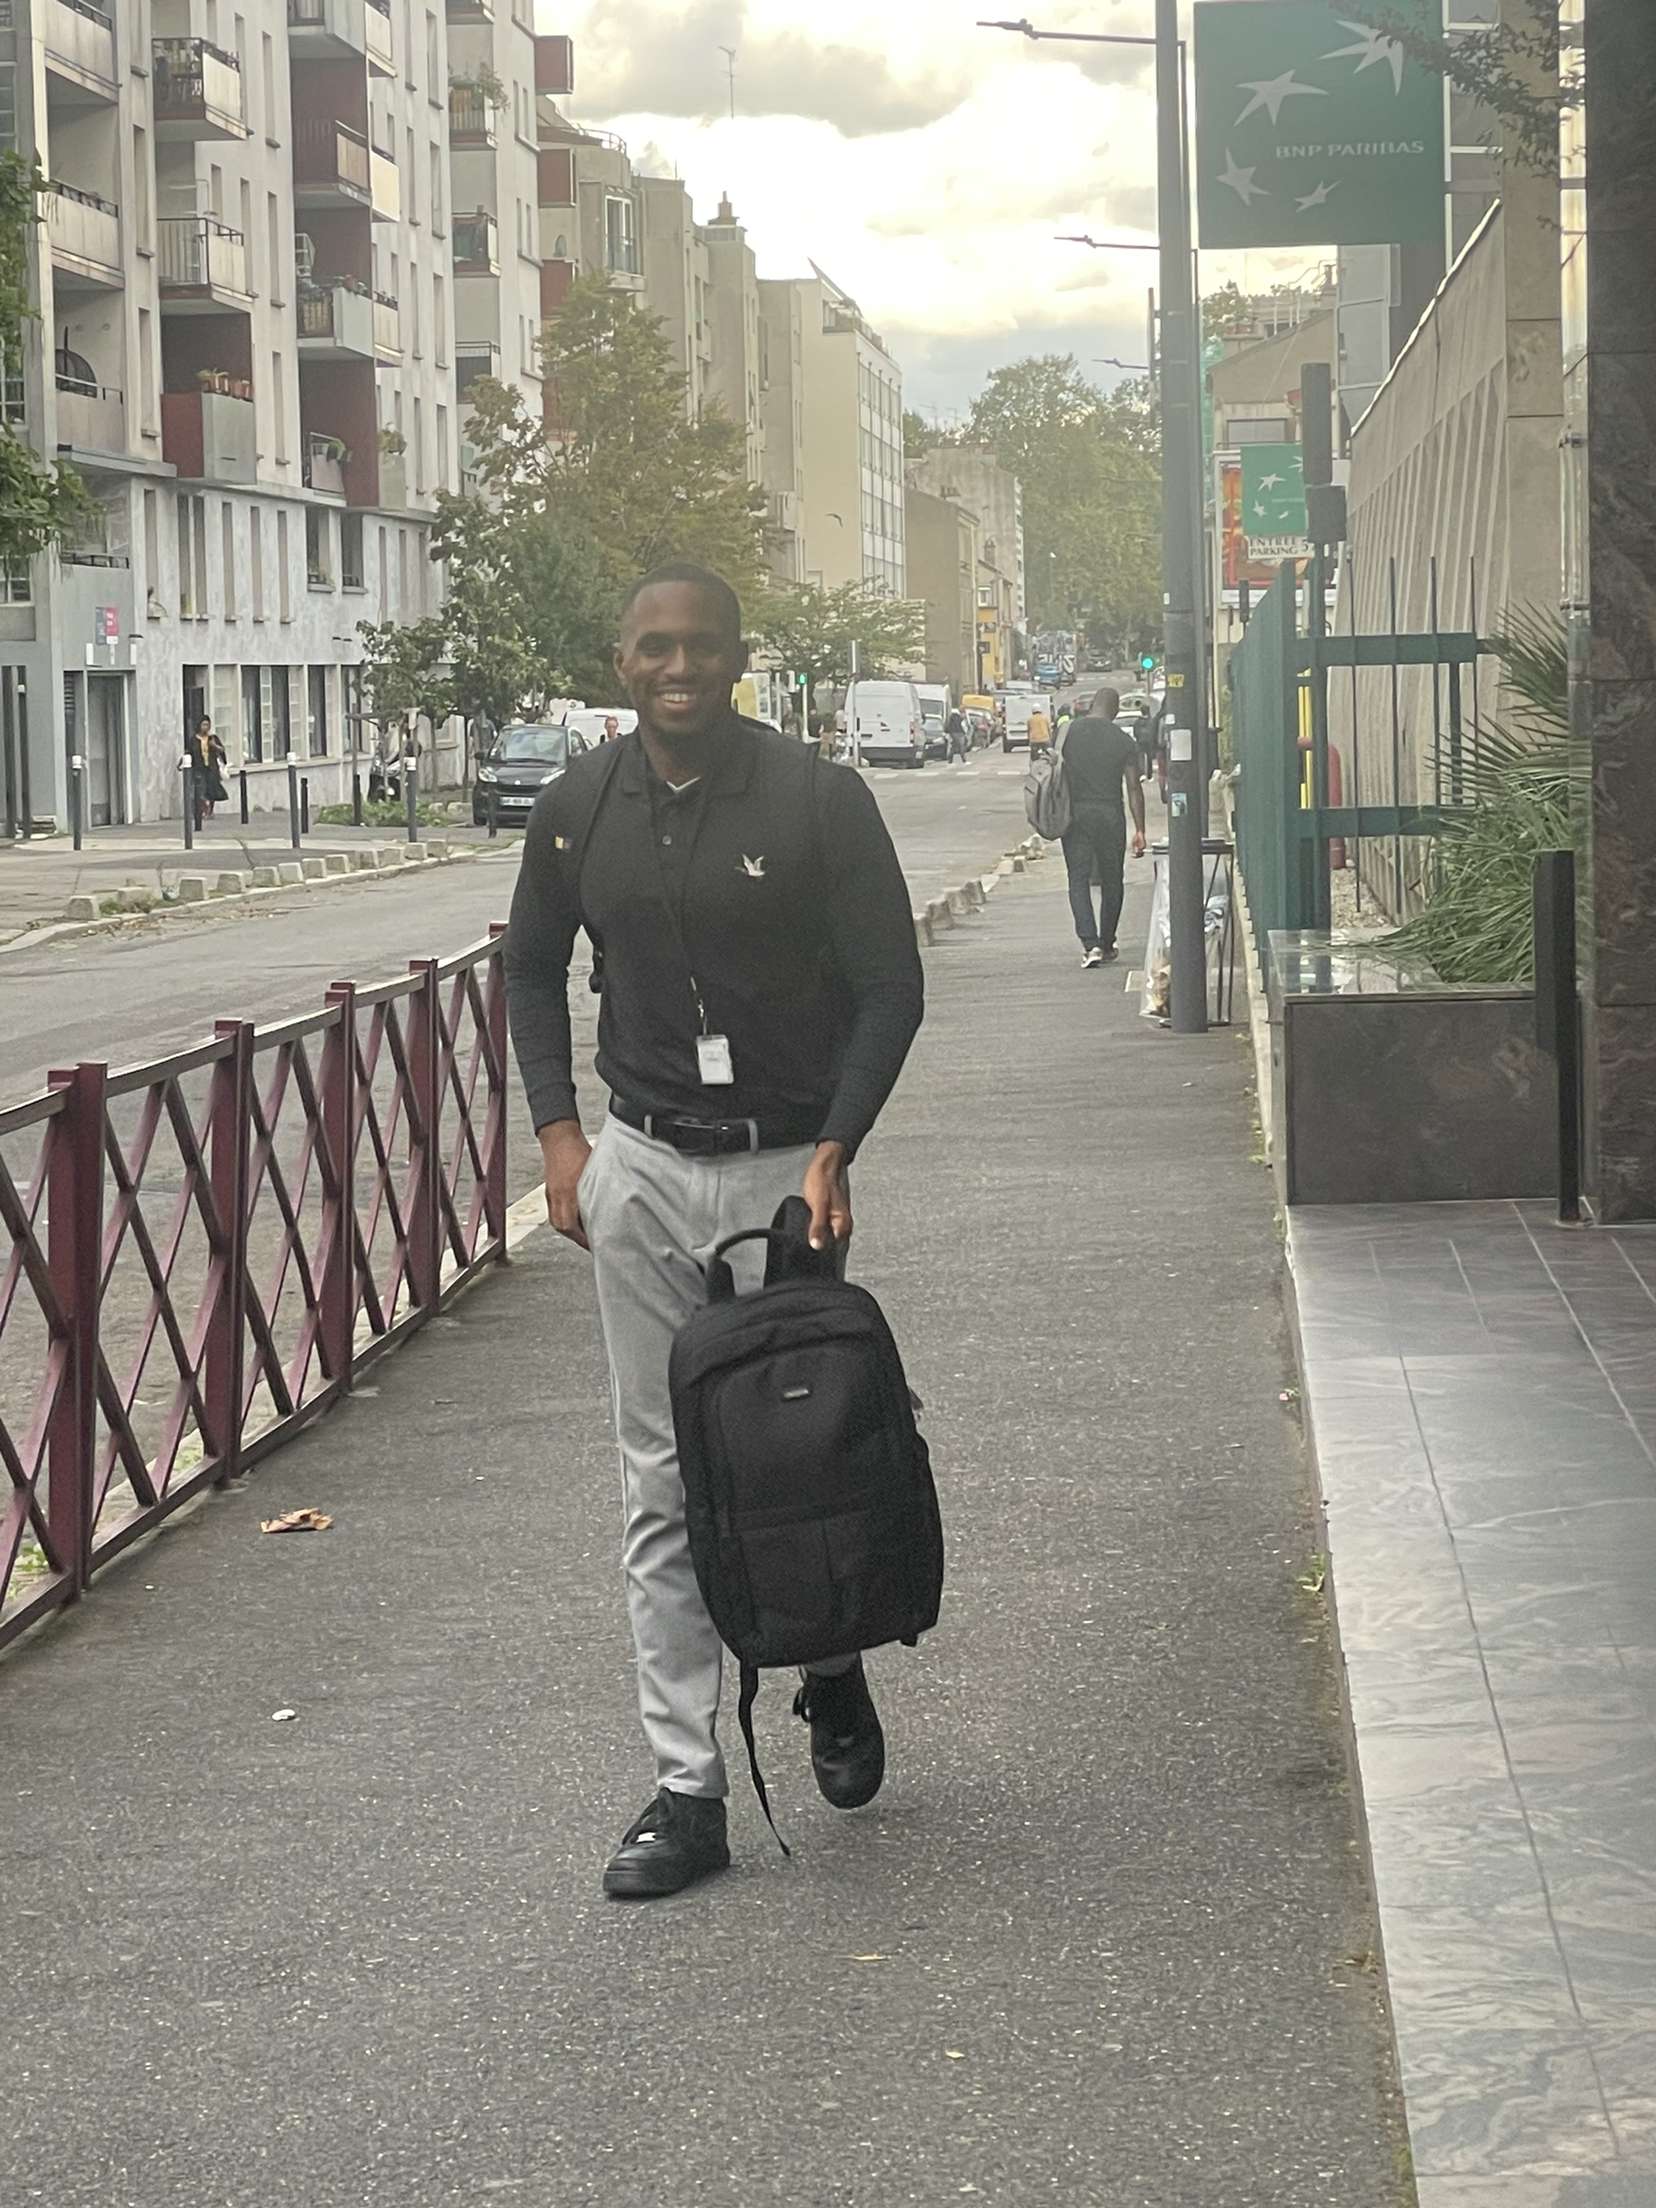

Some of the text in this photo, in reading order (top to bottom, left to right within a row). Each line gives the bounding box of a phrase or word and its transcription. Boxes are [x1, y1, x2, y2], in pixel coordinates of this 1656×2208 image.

[1276, 140, 1424, 158] BNP PARIBAS
[1250, 546, 1298, 556] PARKING
